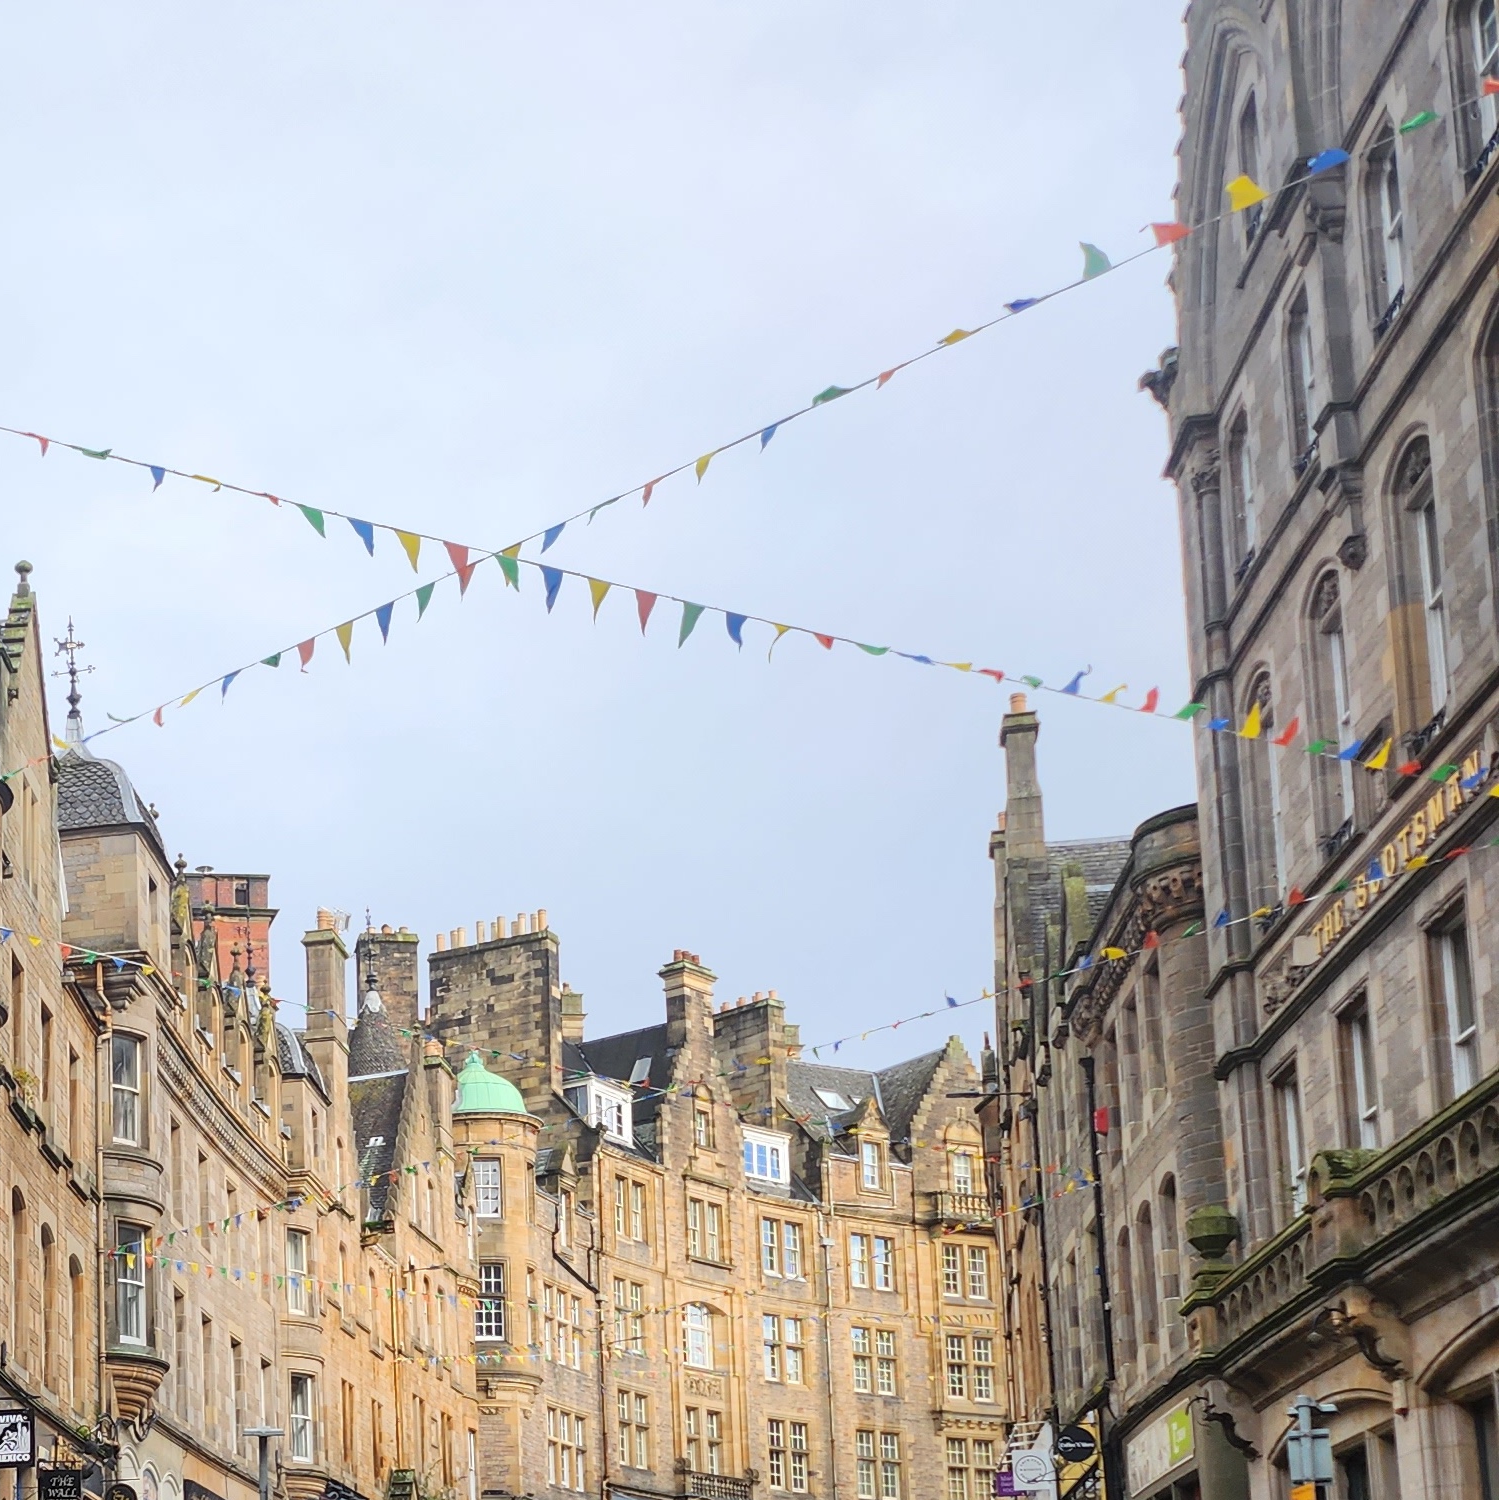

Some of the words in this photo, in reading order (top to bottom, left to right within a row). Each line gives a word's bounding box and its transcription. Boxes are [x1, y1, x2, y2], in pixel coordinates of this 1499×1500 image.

[1313, 899, 1345, 956] THE
[0, 1414, 23, 1423] VIVA
[49, 1474, 75, 1487] THE
[47, 1487, 78, 1500] WALL
